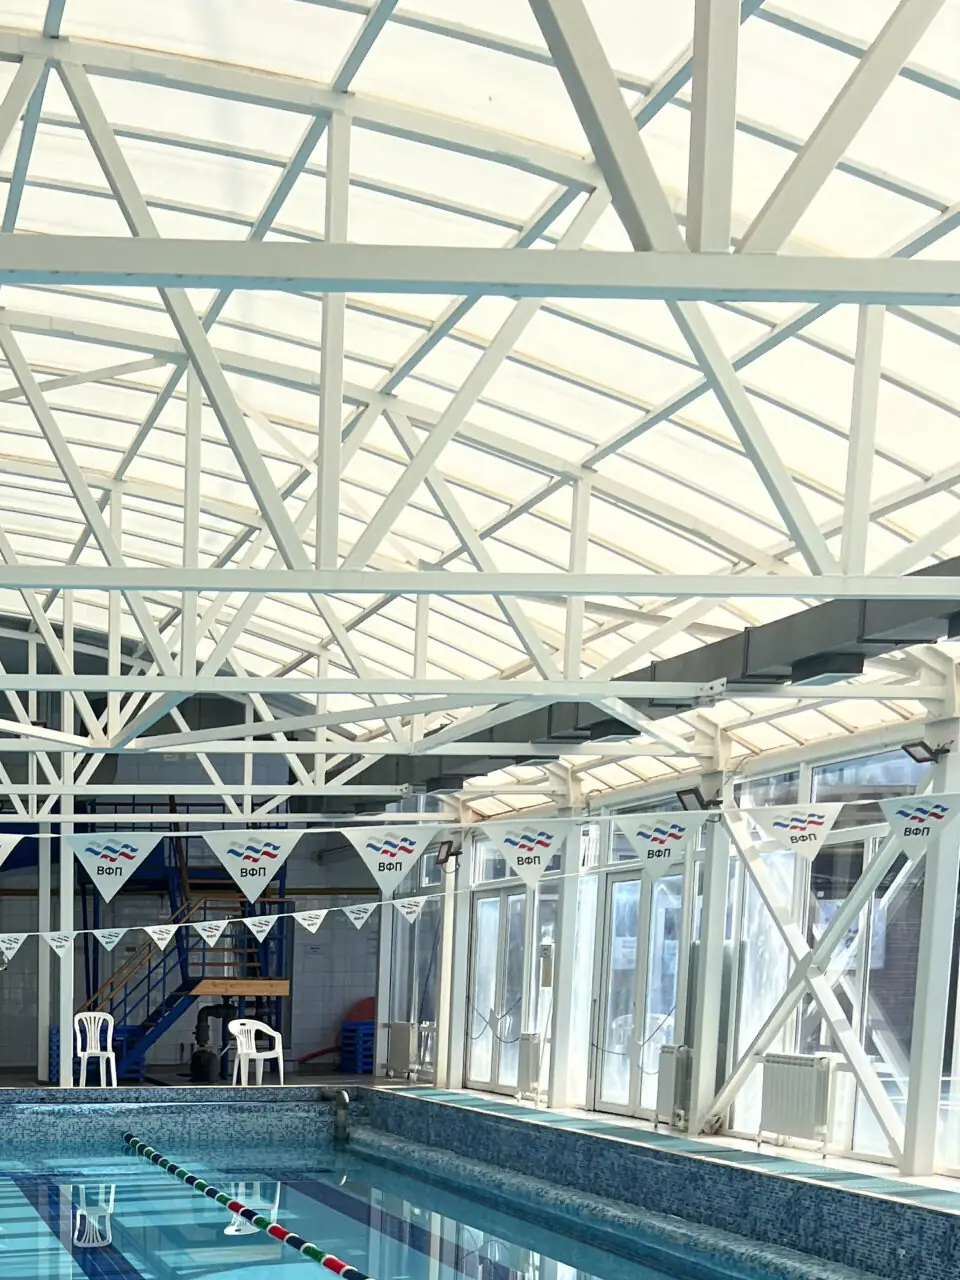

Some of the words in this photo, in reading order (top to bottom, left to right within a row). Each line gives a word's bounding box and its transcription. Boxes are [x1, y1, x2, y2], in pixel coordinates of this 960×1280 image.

[903, 826, 930, 837] ВФП
[790, 833, 817, 844] ВФП
[646, 848, 671, 859] ВФП
[516, 855, 541, 866] ВФП
[96, 866, 123, 877] ВФП
[240, 866, 266, 878] ВФП
[377, 861, 403, 872] ВФП
